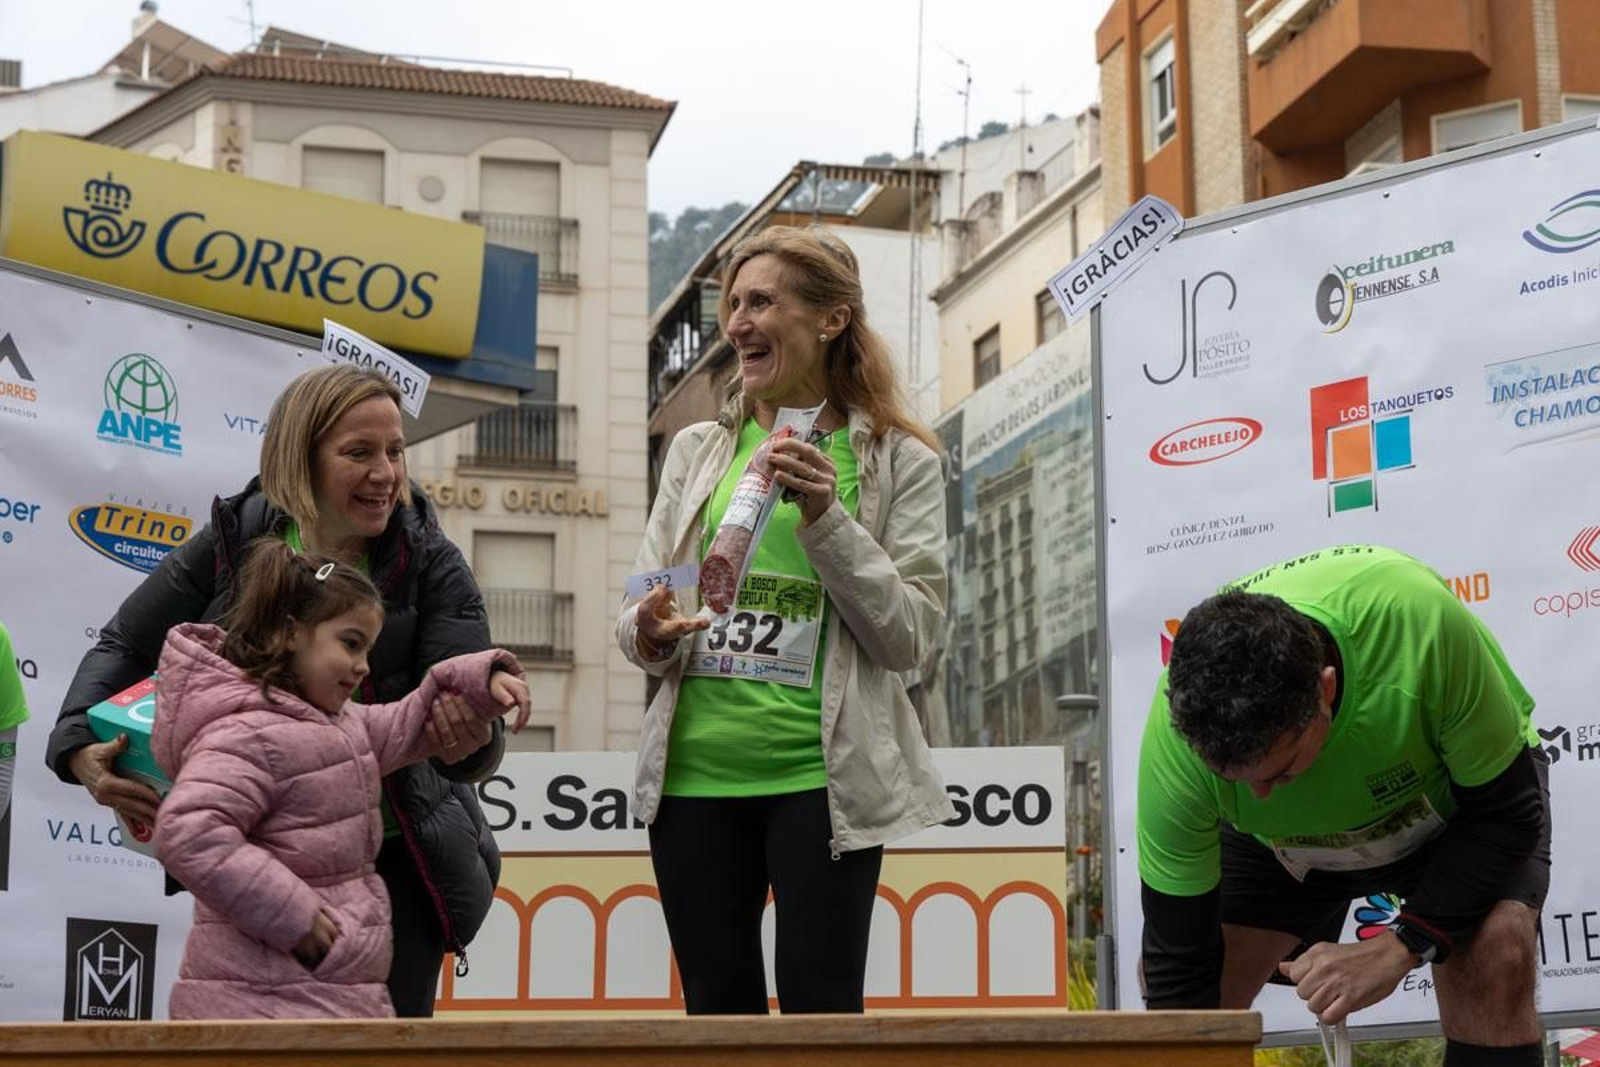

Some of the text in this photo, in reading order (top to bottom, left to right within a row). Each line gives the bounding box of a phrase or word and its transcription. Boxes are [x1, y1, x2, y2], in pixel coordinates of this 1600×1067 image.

[155, 211, 439, 320] CORREOS
[1063, 206, 1166, 305] ¡GRACIAS!
[1519, 274, 1569, 295] Acodis
[1340, 386, 1454, 422] LOS TANQUETOS
[97, 409, 183, 451] ANPE
[1161, 427, 1250, 457] CARCHELEJO
[108, 491, 188, 516] VIAJES
[502, 483, 609, 518] OFICIAL
[105, 506, 187, 542] Trino
[751, 577, 777, 591] BOSCO
[1446, 571, 1490, 603] ND
[708, 612, 783, 656] 332
[478, 774, 1052, 831] S. Sa sco
[67, 853, 162, 871] LABORATORIO
